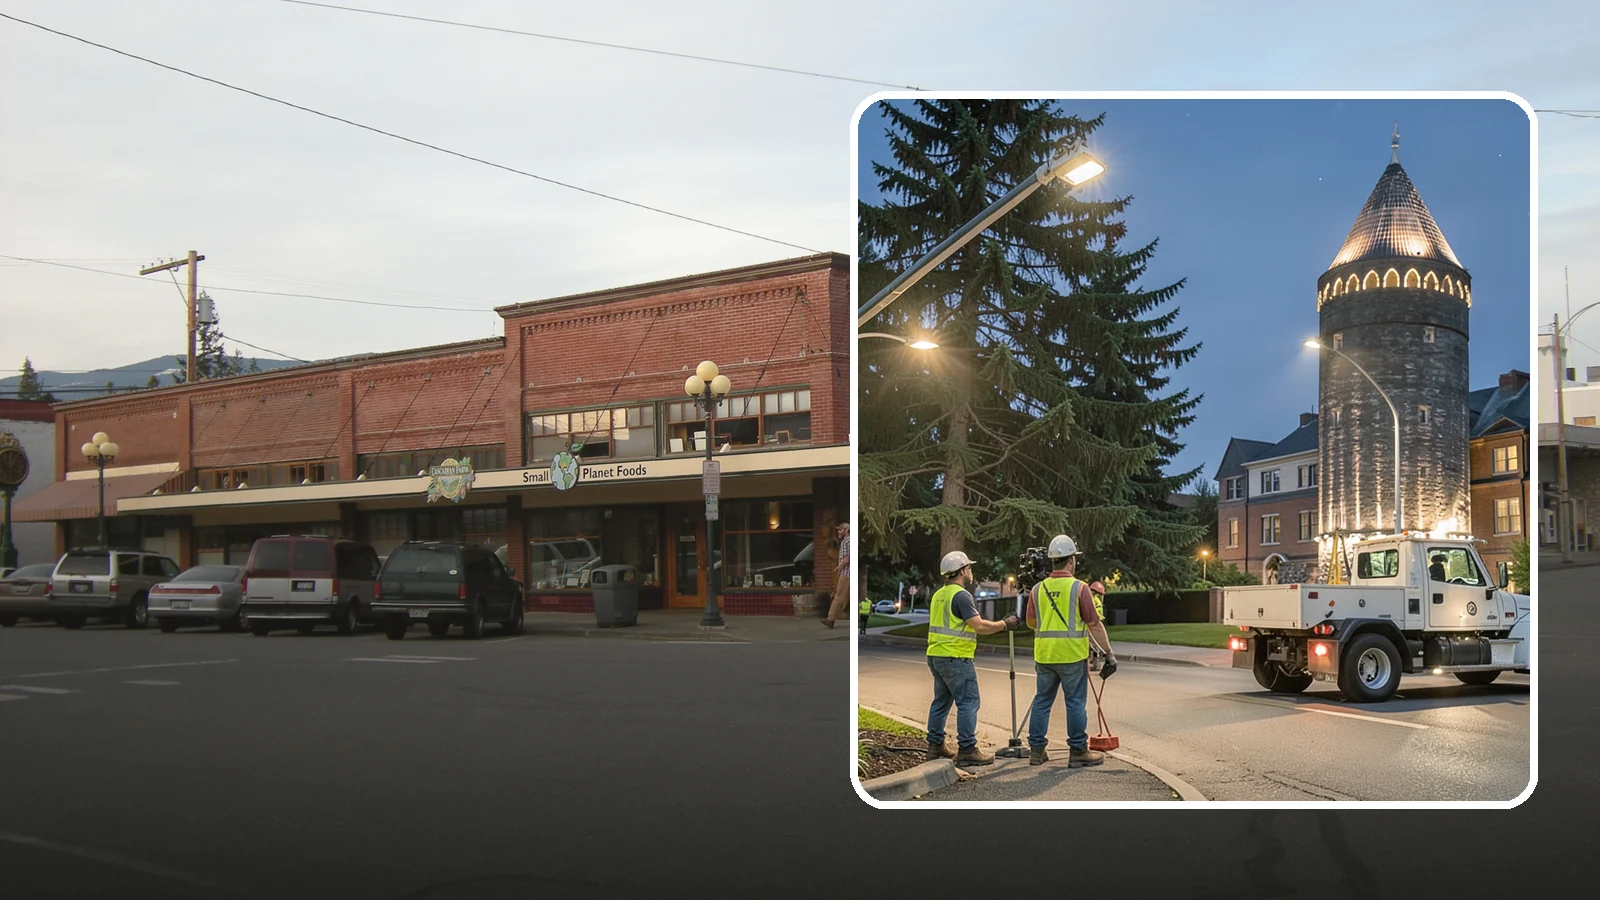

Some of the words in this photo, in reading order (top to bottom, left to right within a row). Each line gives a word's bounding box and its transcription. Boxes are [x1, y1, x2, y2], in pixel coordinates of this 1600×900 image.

[523, 470, 549, 483] Small
[583, 467, 614, 479] Planet
[617, 464, 647, 477] Foods
